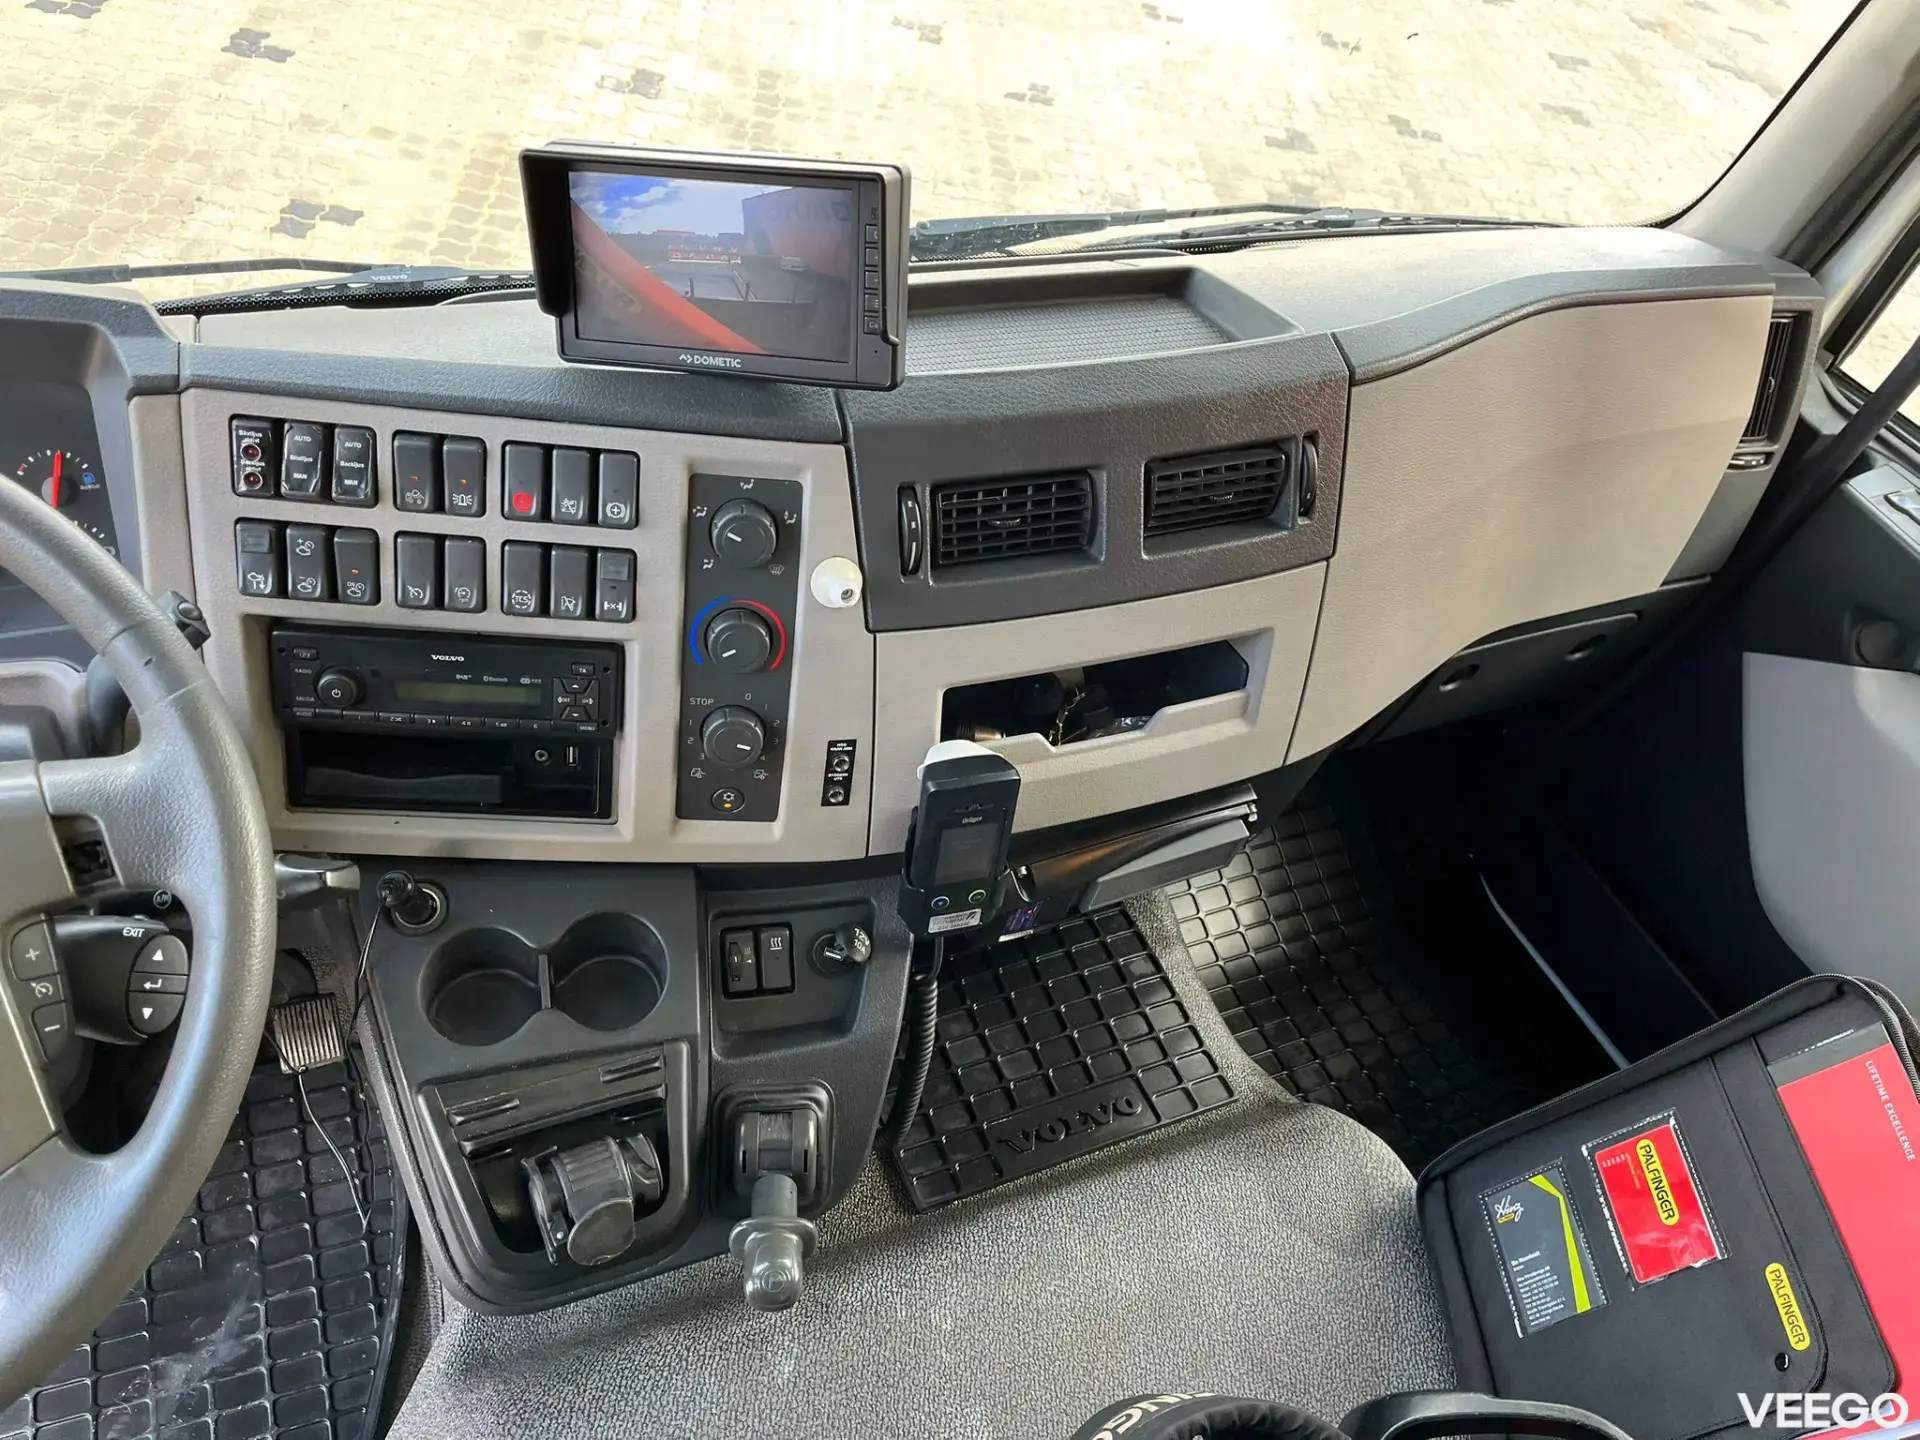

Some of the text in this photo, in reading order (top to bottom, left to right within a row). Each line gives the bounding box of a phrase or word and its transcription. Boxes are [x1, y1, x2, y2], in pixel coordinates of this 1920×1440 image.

[693, 355, 742, 368] DOMETIC
[340, 460, 365, 468] Backljus
[515, 595, 529, 603] TCS
[431, 654, 465, 662] VOLVO
[689, 697, 715, 706] STOP
[773, 719, 780, 727] 2
[687, 736, 694, 744] 2
[773, 737, 780, 745] 3
[699, 752, 705, 760] 3
[962, 816, 983, 824] Dräger
[123, 927, 145, 938] EXIT
[854, 928, 870, 946] 12V
[853, 939, 866, 955] 10A
[1865, 1060, 1916, 1162] LIFETIME EXCELLENCE
[999, 1097, 1143, 1154] VOLVO
[1639, 1143, 1676, 1221] PALFINGER
[1769, 1268, 1806, 1345] PALFINGER
